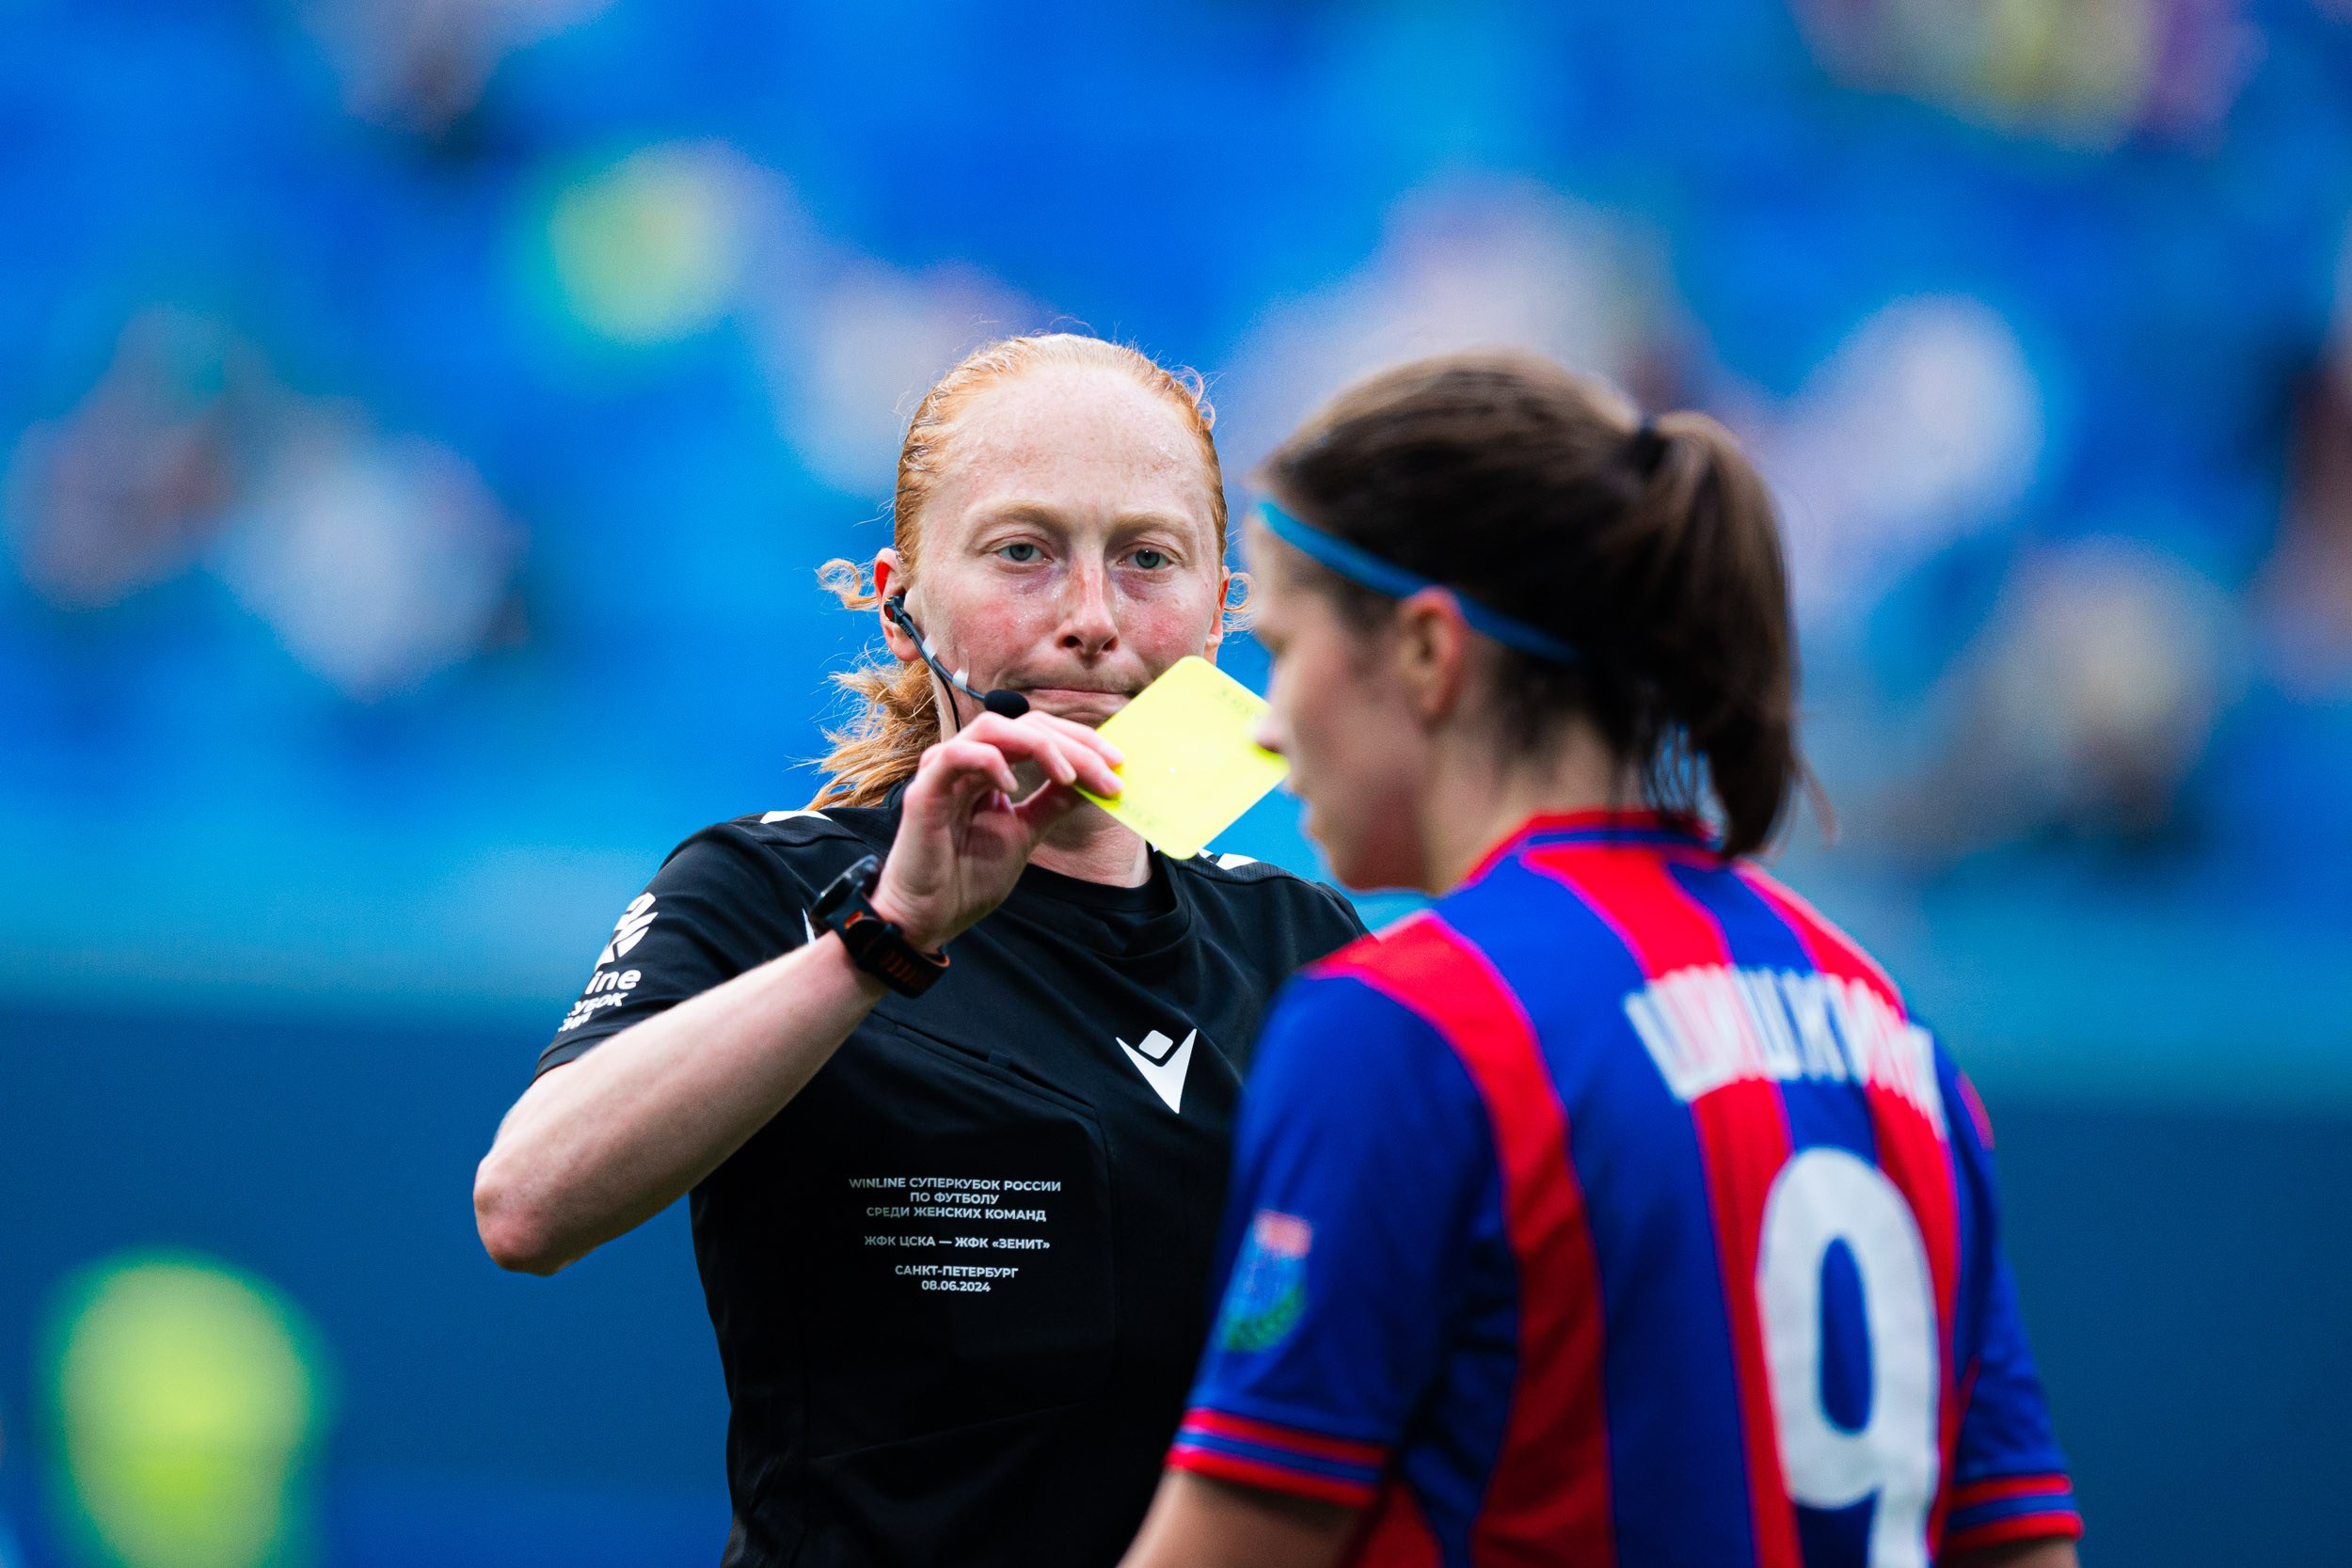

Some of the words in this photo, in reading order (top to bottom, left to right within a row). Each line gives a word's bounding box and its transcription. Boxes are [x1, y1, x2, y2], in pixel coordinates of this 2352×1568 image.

[850, 1178, 906, 1187] WINLINE
[910, 1178, 1000, 1190] СУПЕРКУБОК
[1004, 1180, 1060, 1191] РОССИИ
[911, 1192, 930, 1202] ПО
[934, 1192, 999, 1204] ФУТБОЛУ
[867, 1207, 909, 1217] СРЕДИ
[914, 1207, 981, 1218] ЖЕНСКИХ
[985, 1209, 1046, 1222] КОМАНД
[866, 1236, 896, 1245] ЖФК
[900, 1236, 935, 1247] ЦСКА
[955, 1237, 988, 1248] ЖФК
[992, 1238, 1050, 1249] «ЗЕНИТ»
[896, 1265, 1019, 1278] САНКТ-ПЕТЕРБУРГ
[922, 1280, 991, 1291] 08.06.2024
[1754, 1148, 1941, 1568] 9
